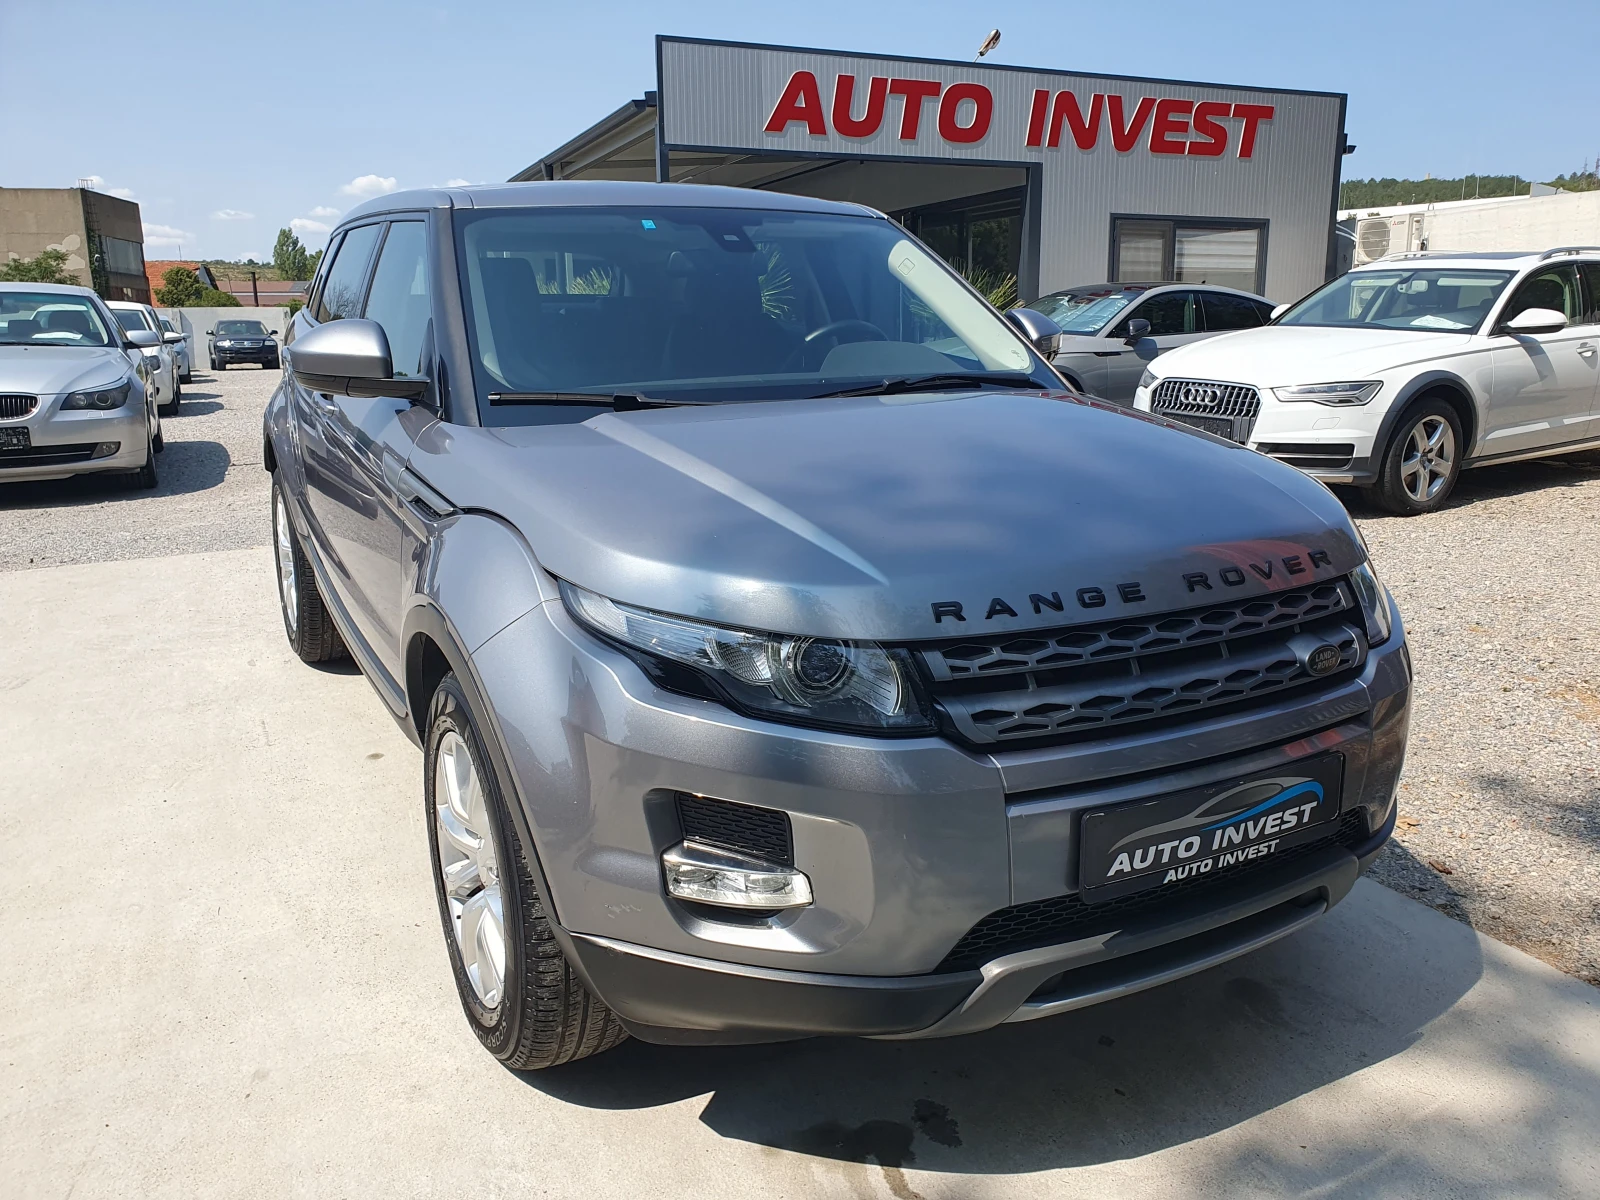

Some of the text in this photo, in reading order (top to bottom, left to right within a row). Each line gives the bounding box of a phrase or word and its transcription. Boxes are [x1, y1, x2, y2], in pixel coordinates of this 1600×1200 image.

[763, 70, 1275, 159] AUTO INVEST
[931, 549, 1332, 624] RANGE ROVER
[1107, 801, 1318, 877] AUTO INVEST
[1163, 839, 1279, 884] AUTO INVEST
